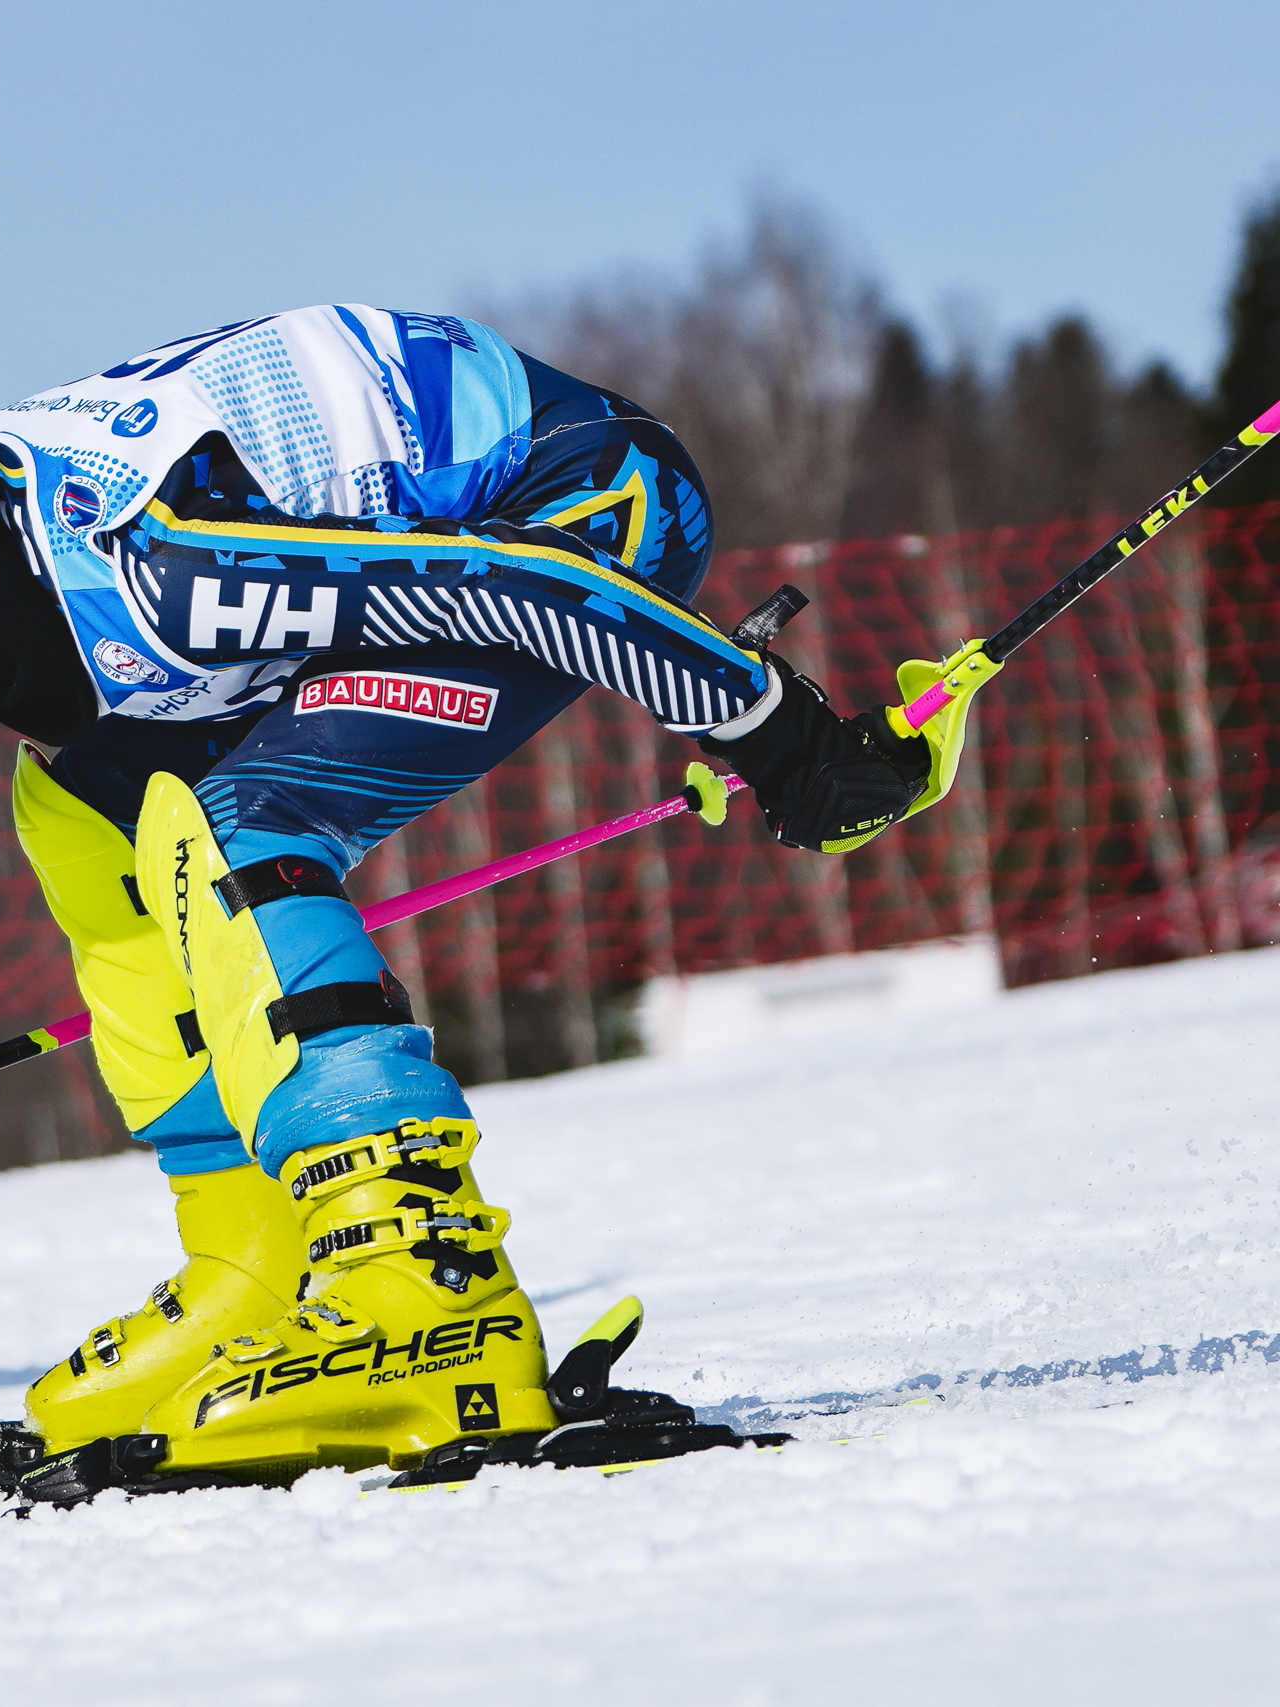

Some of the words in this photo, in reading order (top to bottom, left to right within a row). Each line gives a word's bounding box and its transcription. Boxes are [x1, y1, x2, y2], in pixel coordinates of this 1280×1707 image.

[1117, 475, 1210, 557] LEKI
[189, 576, 339, 649] HH
[303, 676, 488, 723] BAUHAUS
[839, 812, 894, 834] LEKI
[194, 1314, 524, 1429] FISCHER
[367, 1369, 407, 1386] RC4
[410, 1350, 484, 1377] PODIUM
